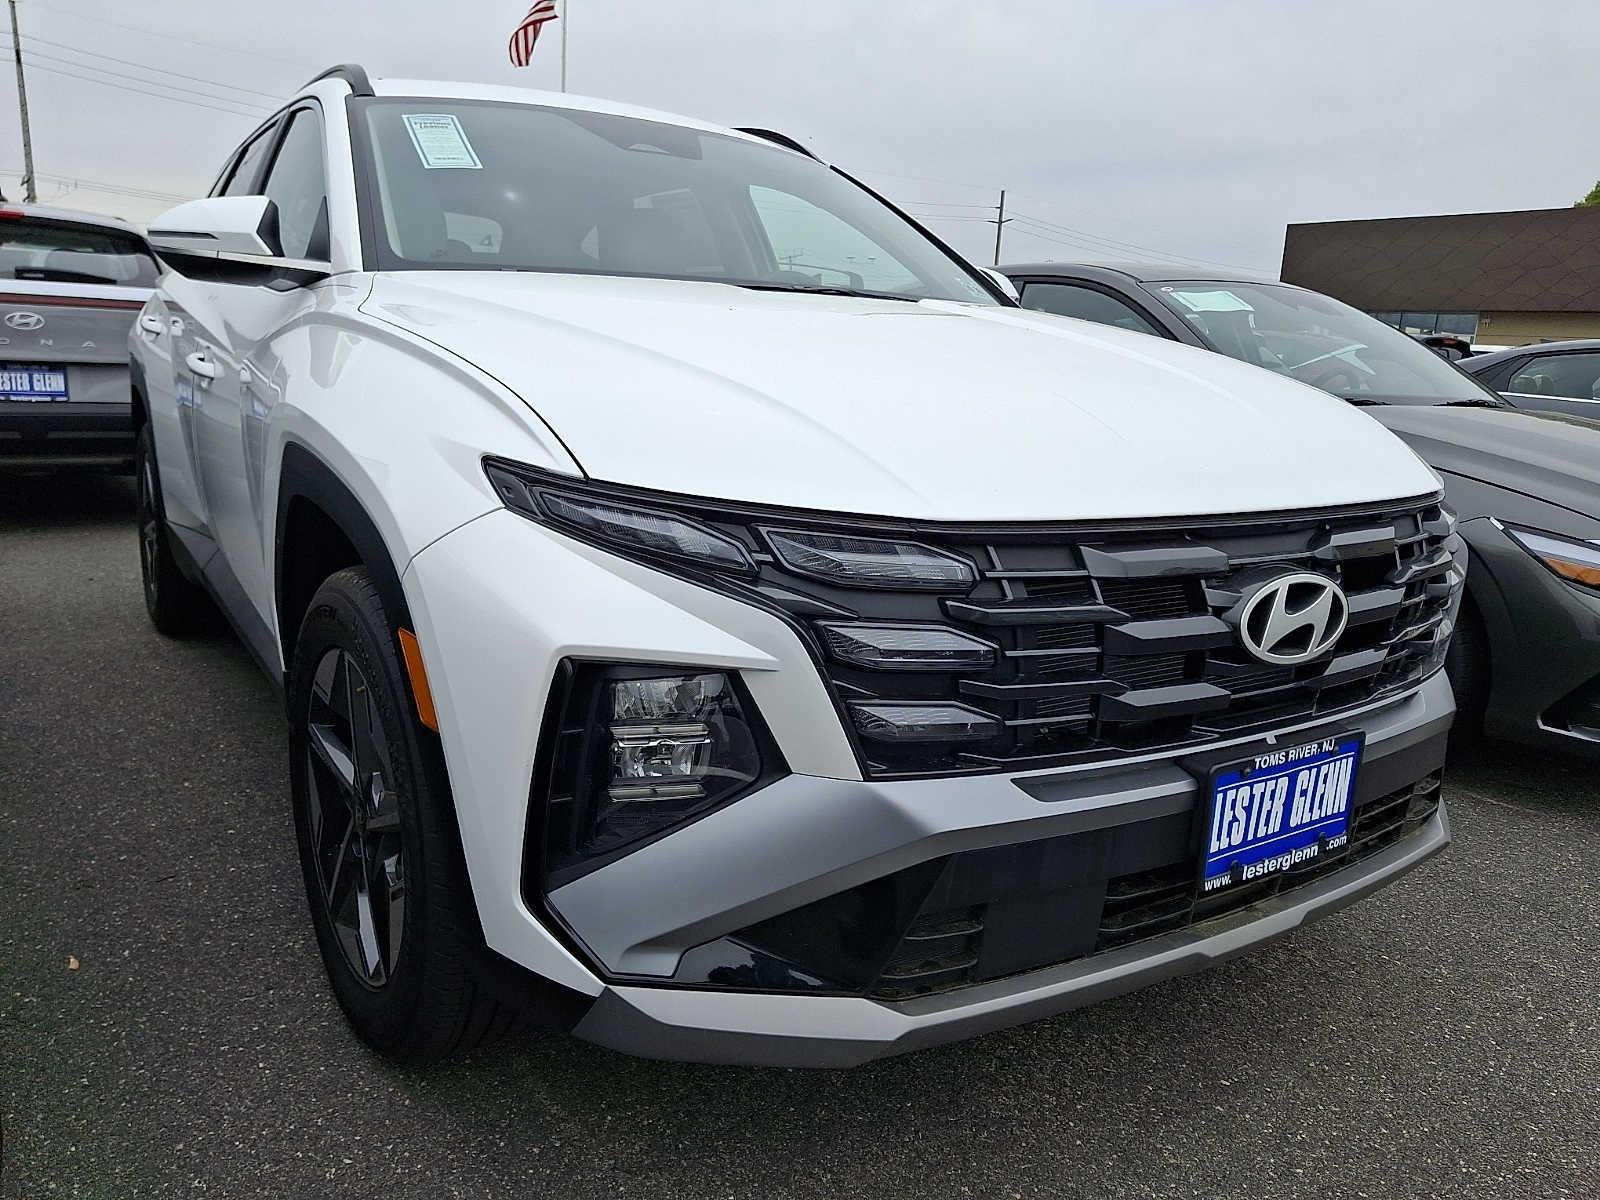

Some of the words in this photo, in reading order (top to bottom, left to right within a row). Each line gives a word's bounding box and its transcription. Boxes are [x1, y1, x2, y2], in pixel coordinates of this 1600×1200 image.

[1254, 753, 1286, 770] TOMS
[1288, 743, 1321, 762] RIVER,
[1322, 739, 1335, 753] NJ
[1209, 776, 1289, 854] LESTER
[1289, 757, 1354, 828] GLENN
[1242, 845, 1319, 880] lesterglenn
[1325, 835, 1347, 851] .com
